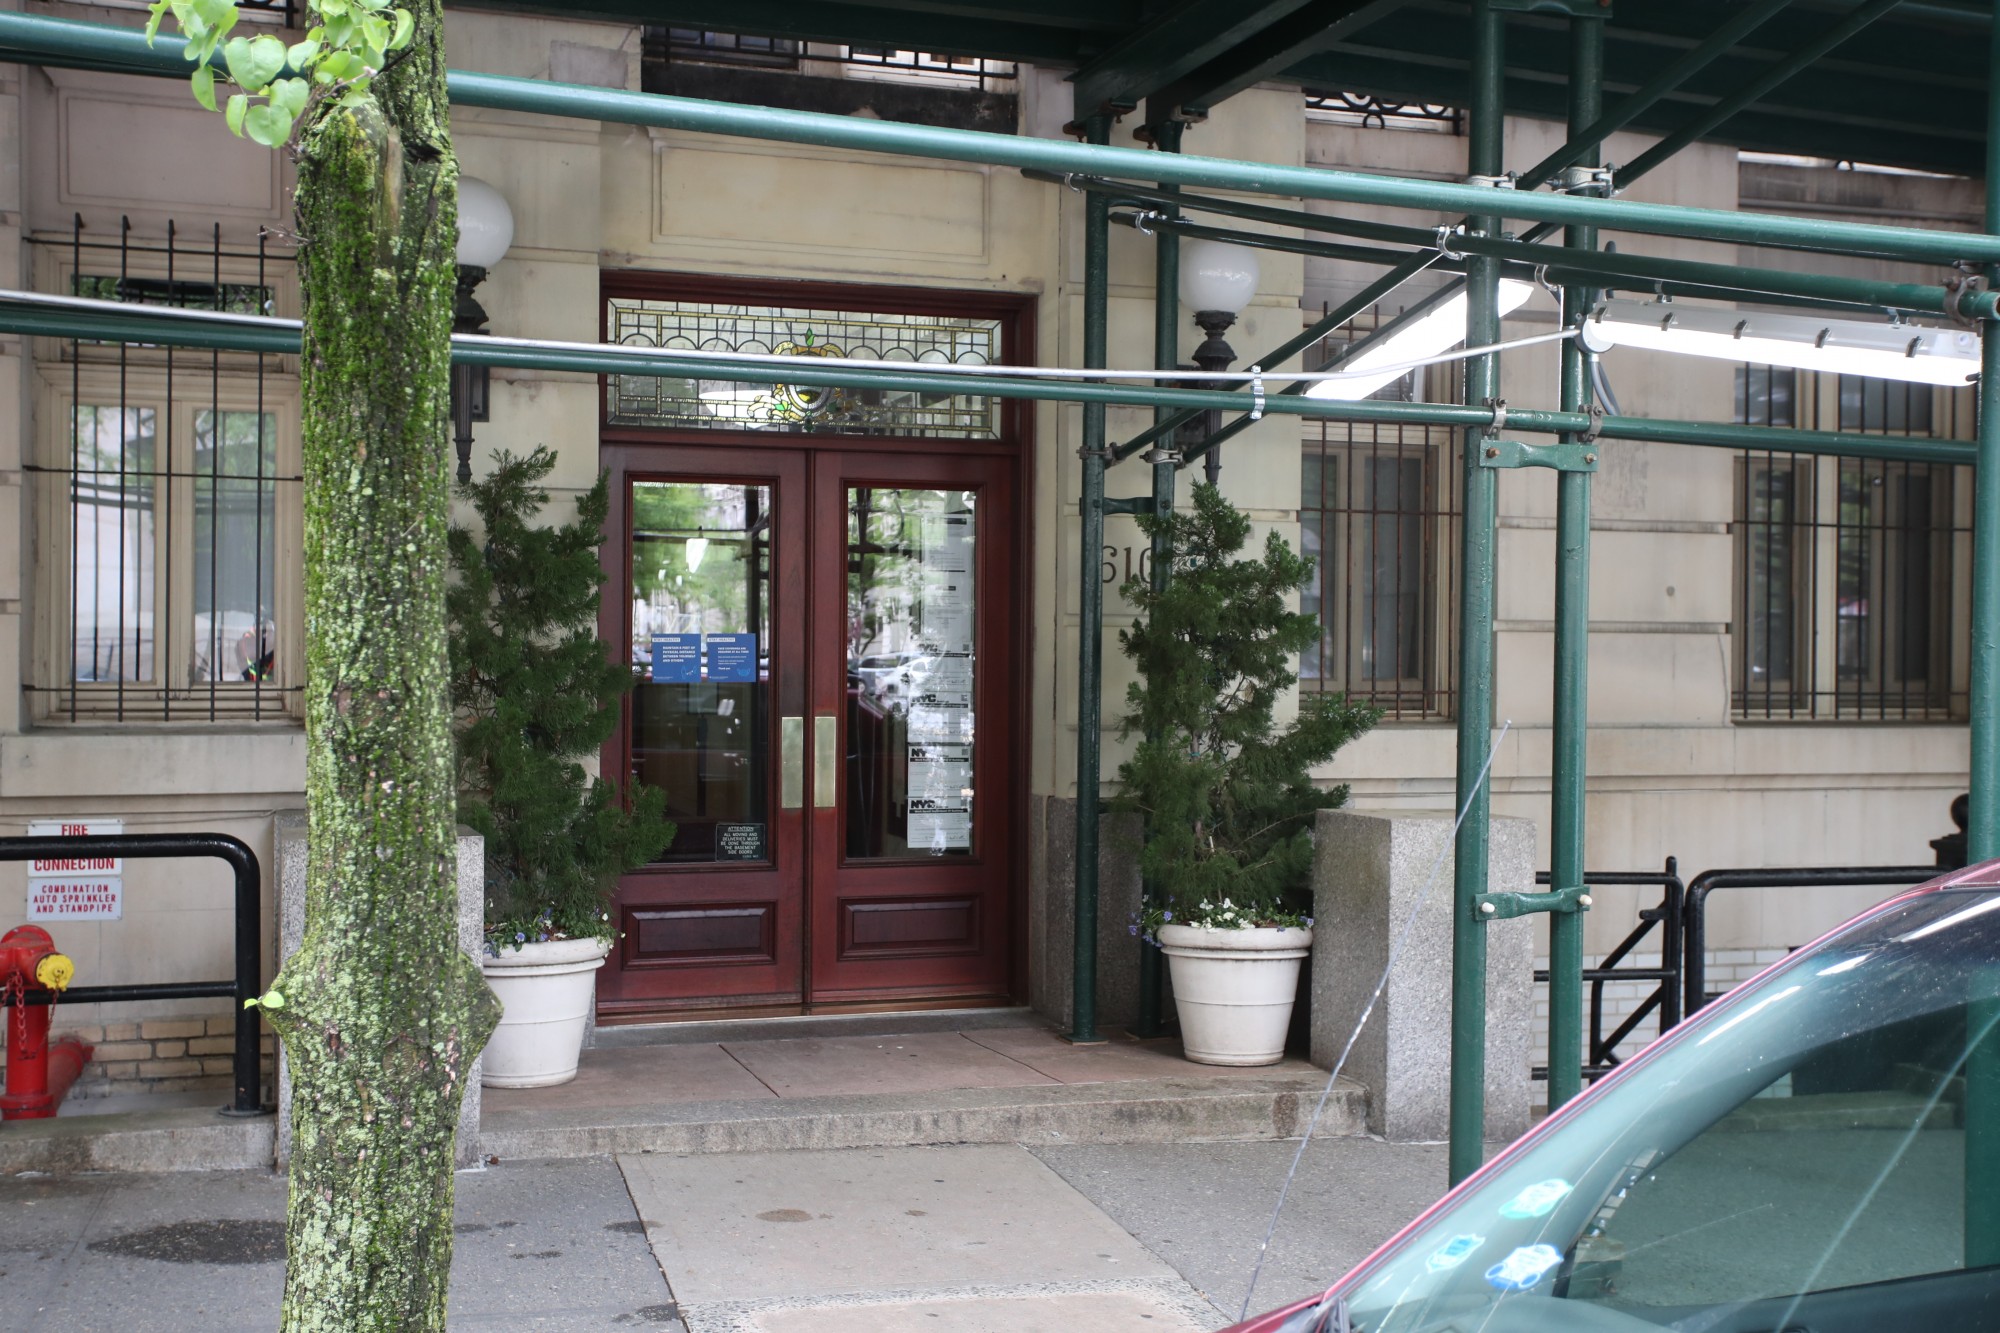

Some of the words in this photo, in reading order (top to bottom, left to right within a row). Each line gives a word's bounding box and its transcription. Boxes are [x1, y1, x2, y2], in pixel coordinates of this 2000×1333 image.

[911, 748, 927, 757] NY
[911, 800, 935, 808] NYC
[61, 824, 89, 837] FIRE
[34, 857, 115, 871] CONNECTION
[42, 884, 109, 894] COMBINATION
[33, 894, 58, 903] AUTO
[62, 894, 116, 903] SPRINKLER
[36, 904, 54, 913] AND
[59, 904, 113, 913] STANDPIPE
